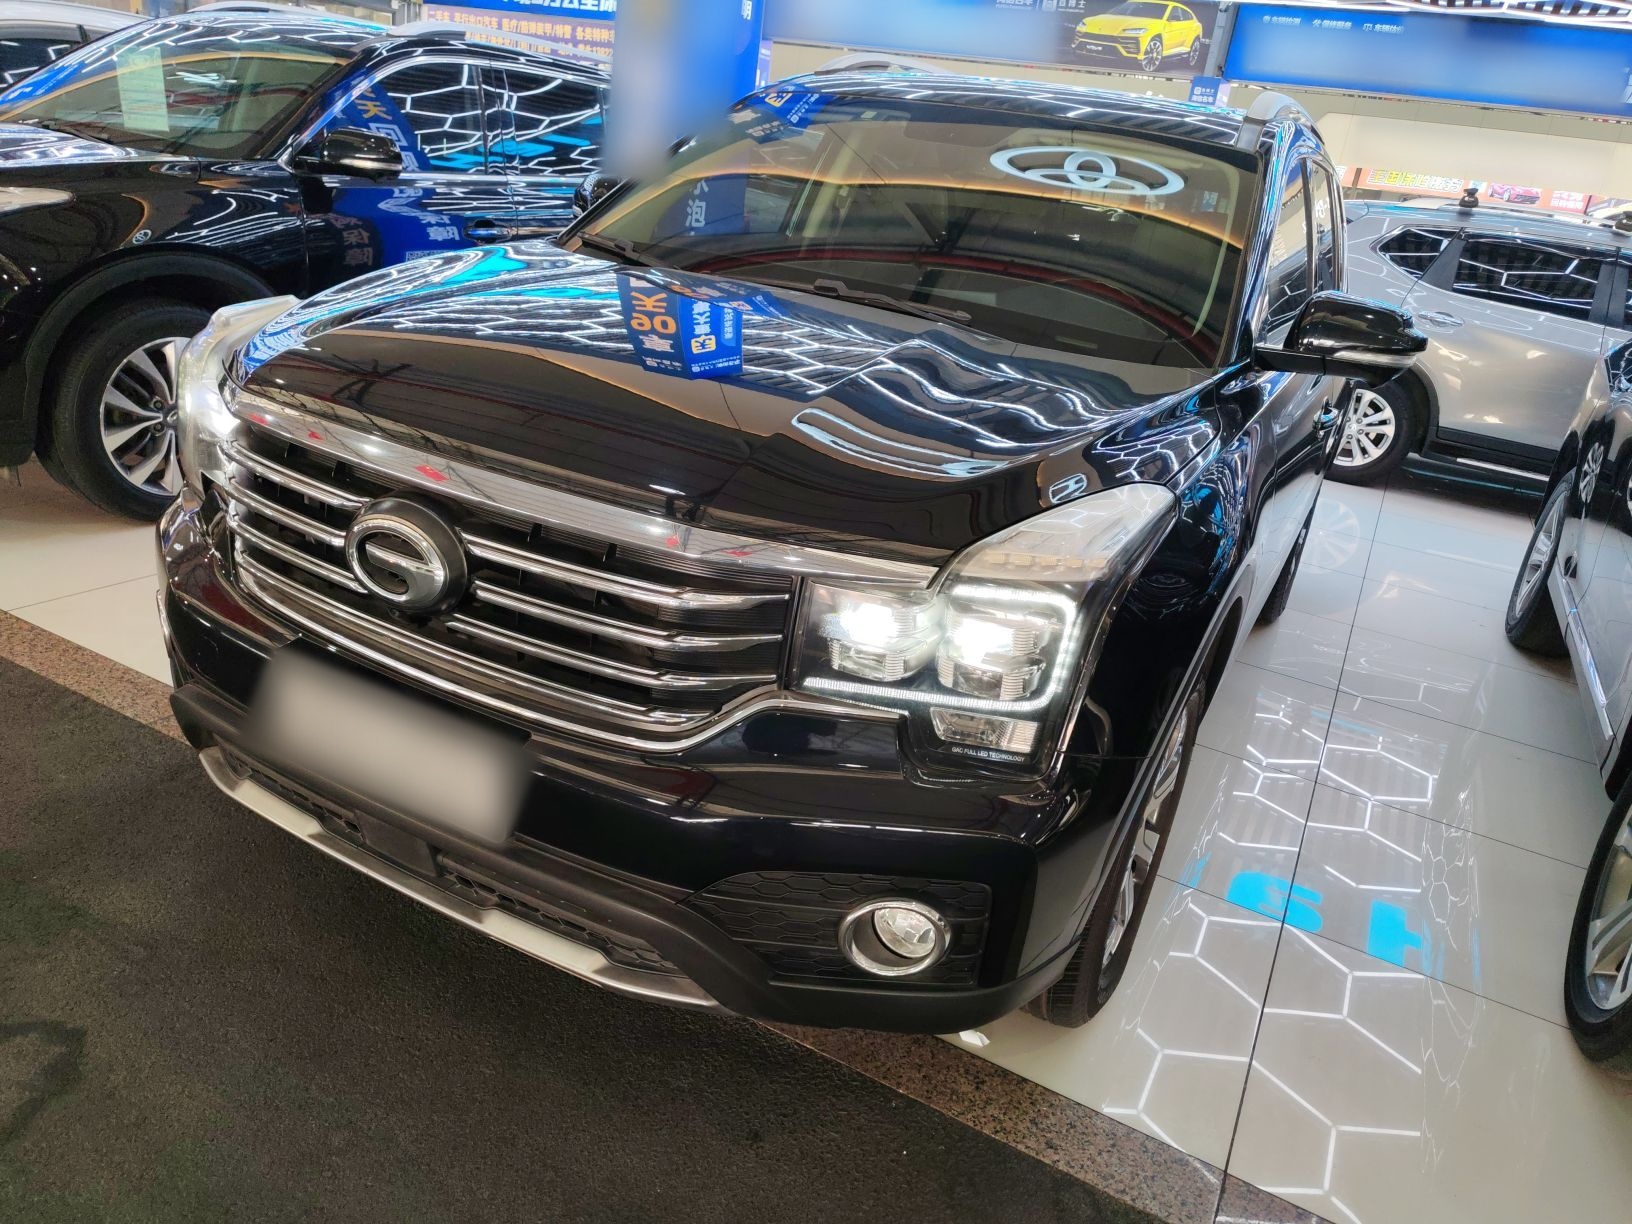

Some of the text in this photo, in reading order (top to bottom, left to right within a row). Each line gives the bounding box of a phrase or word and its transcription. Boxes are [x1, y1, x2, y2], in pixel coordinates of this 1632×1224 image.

[951, 746, 964, 754] GAC
[964, 748, 977, 756] FULL
[989, 752, 1025, 762] TECHNOLOGY
